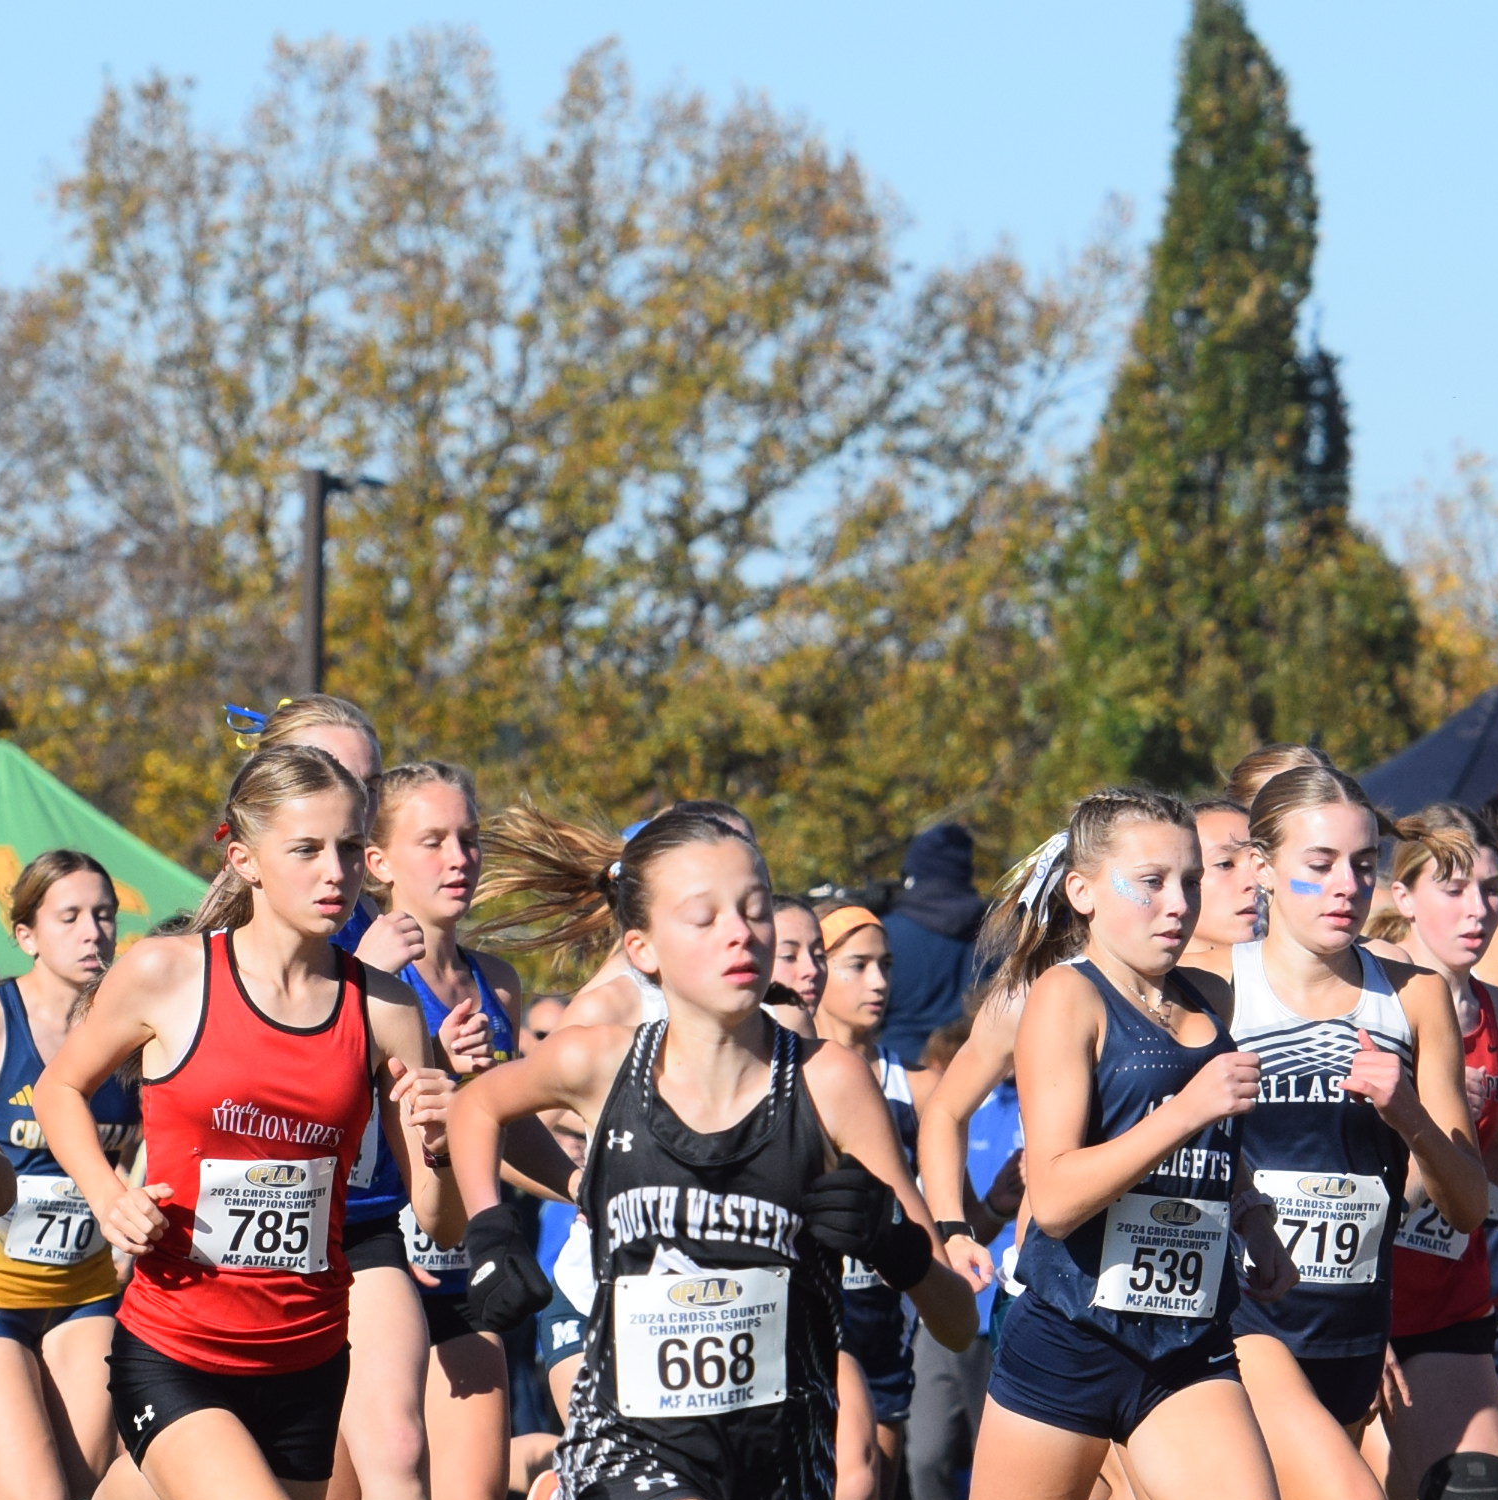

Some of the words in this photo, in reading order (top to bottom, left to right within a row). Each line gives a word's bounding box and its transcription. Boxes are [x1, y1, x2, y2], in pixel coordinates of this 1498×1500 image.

[218, 1098, 260, 1117] Lady
[212, 1108, 344, 1148] MILLIONAIRES
[253, 1167, 302, 1184] PIAA
[210, 1188, 239, 1197] 2024
[243, 1190, 281, 1199] CROSS
[285, 1187, 326, 1200] COUNTRY
[1307, 1177, 1355, 1196] PIAA
[224, 1198, 316, 1209] CHAMPIONSHIPS
[1296, 1199, 1332, 1209] CROSS
[1336, 1202, 1381, 1212] COUNTRY
[607, 1186, 679, 1254] SOUTH
[687, 1188, 802, 1260] WESTERN
[1278, 1207, 1366, 1221] CHAMPIONSHIPS
[35, 1214, 94, 1250] 710
[228, 1209, 309, 1254] 785
[1116, 1222, 1145, 1234] 2024
[1147, 1226, 1179, 1237] CROSS
[1181, 1230, 1222, 1241] COUNTRY
[1131, 1235, 1210, 1250] CHAMPIONSHIPS
[1282, 1218, 1360, 1265] 719
[1407, 1234, 1451, 1253] ATHLETIC
[45, 1248, 85, 1260] ATHLETIC
[243, 1255, 306, 1268] ATHLETIC
[428, 1254, 466, 1265] ATHLETIC
[1129, 1247, 1203, 1296] 539
[1300, 1265, 1354, 1278] ATHLETIC
[680, 1280, 740, 1303] PIAA
[630, 1314, 664, 1324] 2024
[669, 1311, 716, 1323] CROSS
[721, 1302, 777, 1319] COUNTRY
[1144, 1296, 1198, 1311] ATHLETIC
[551, 1320, 581, 1350] M
[649, 1317, 761, 1336] CHAMPIONSHIPS
[658, 1332, 754, 1390] 668
[686, 1386, 754, 1408] ATHLETIC
